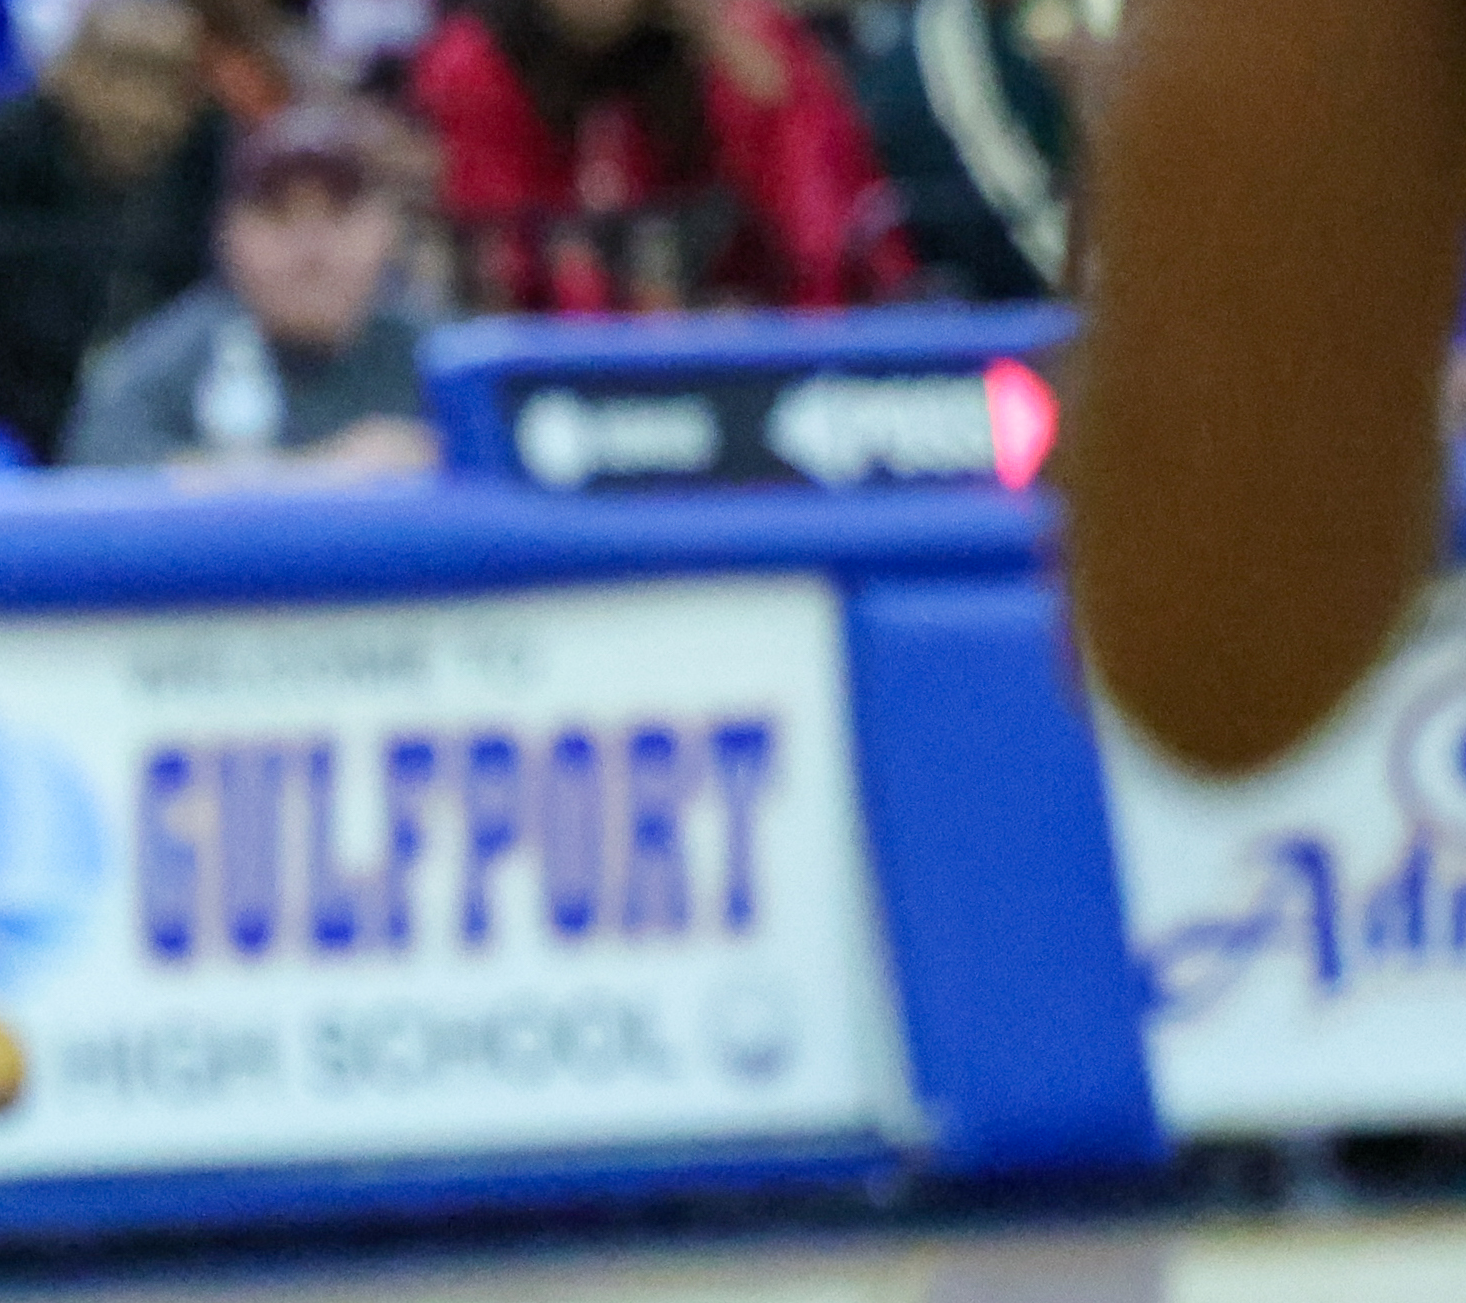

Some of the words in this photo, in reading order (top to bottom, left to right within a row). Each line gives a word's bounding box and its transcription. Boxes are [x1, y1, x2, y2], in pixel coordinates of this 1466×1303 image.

[136, 713, 783, 972] GULFPORT
[55, 1024, 283, 1099] HIGH
[308, 997, 675, 1087] SCHOOL
